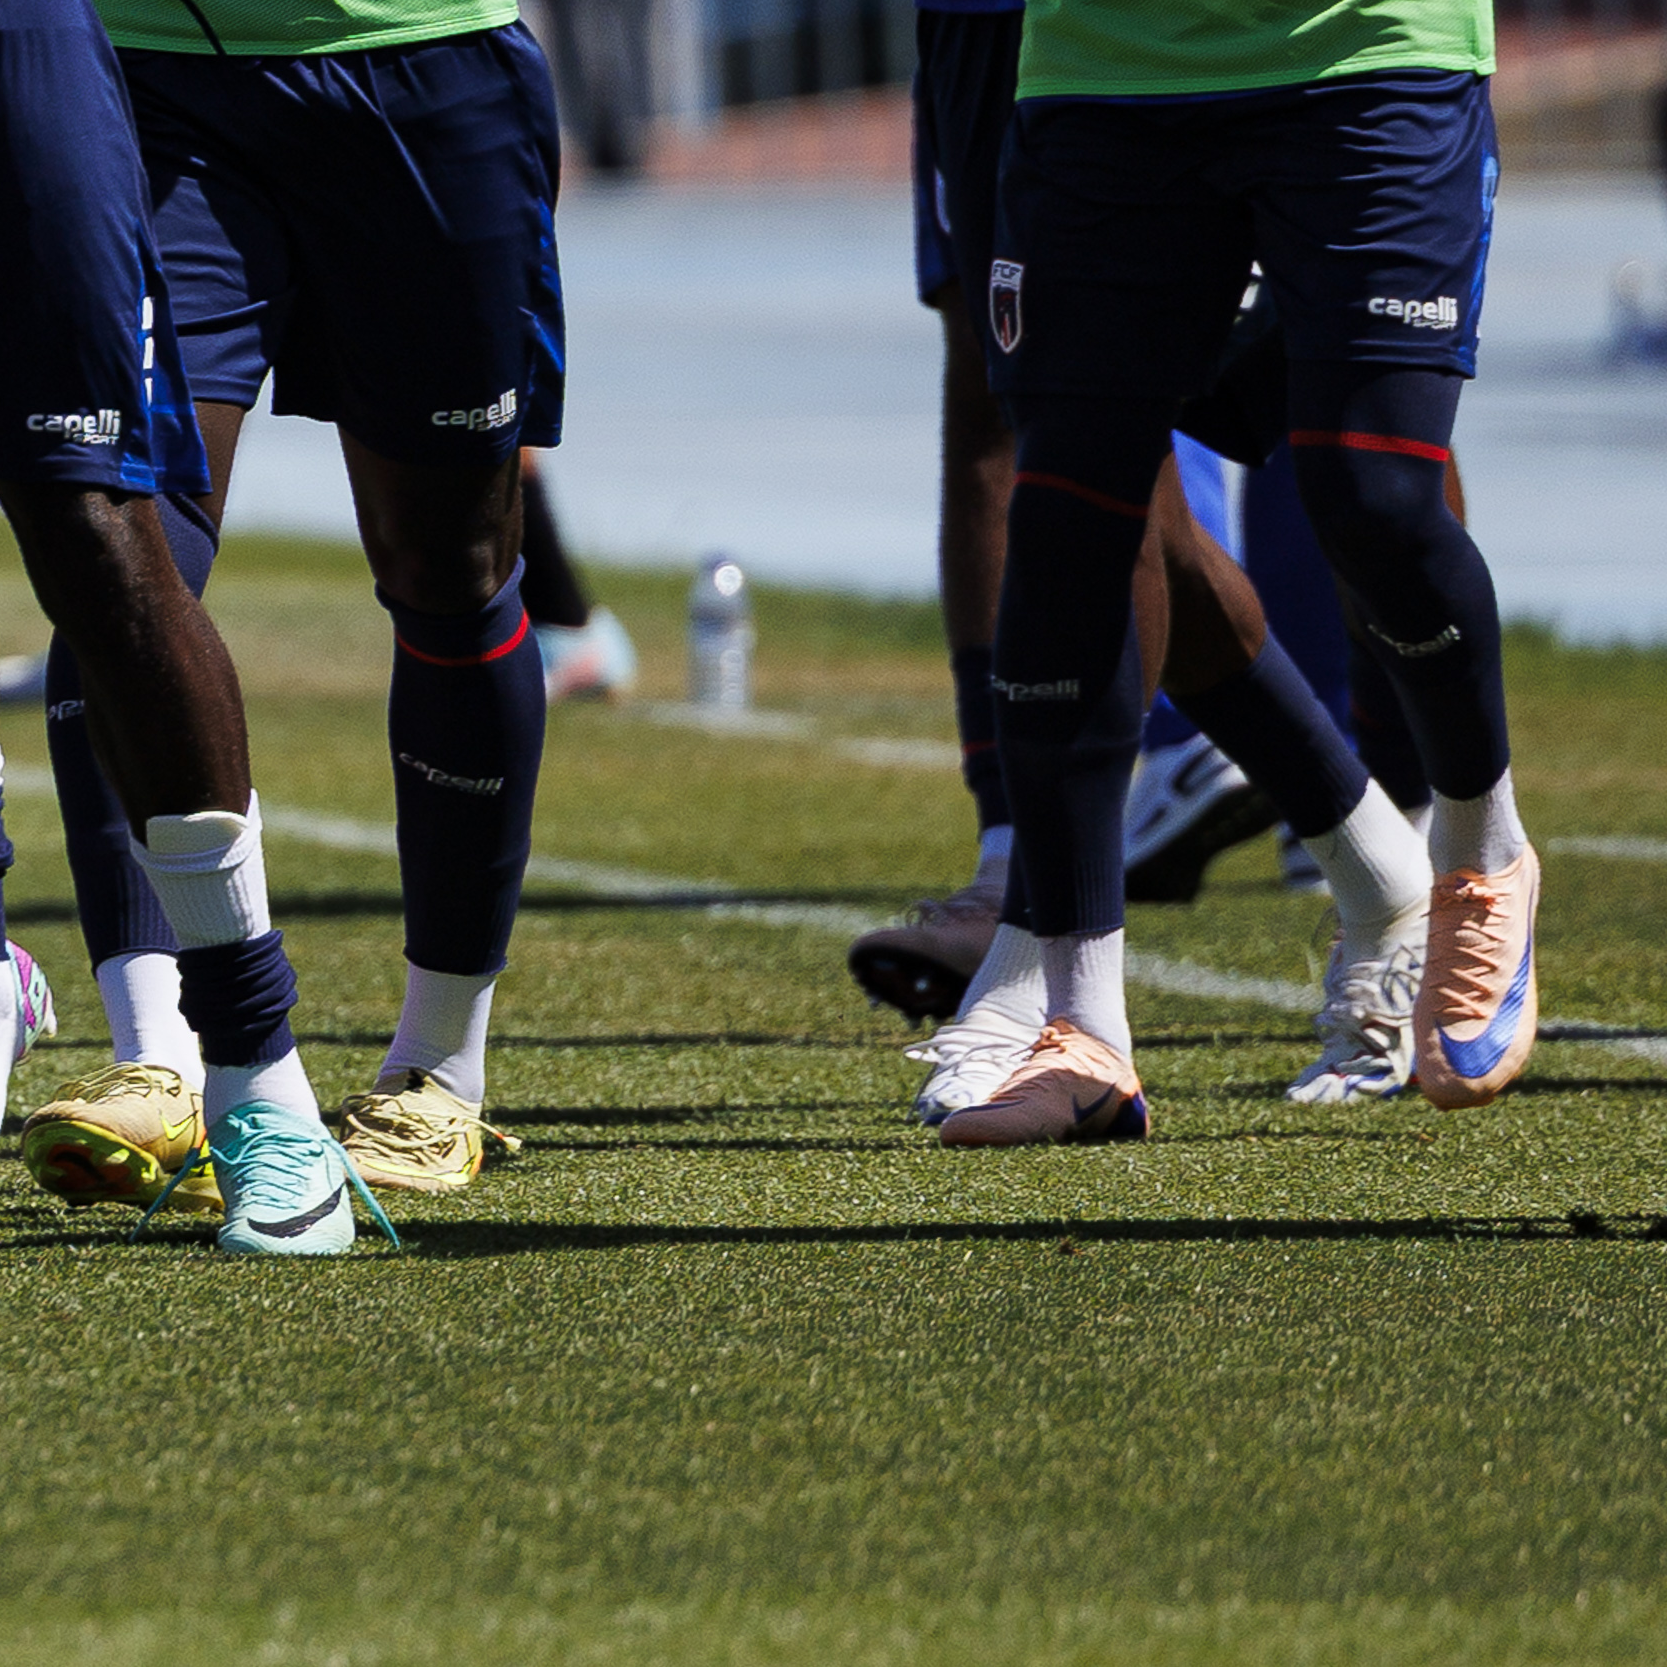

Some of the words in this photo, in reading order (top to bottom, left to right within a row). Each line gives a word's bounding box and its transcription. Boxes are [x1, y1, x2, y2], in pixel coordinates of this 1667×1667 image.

[1368, 296, 1458, 324] capelli
[431, 387, 516, 430] capelli
[27, 409, 121, 439] capelli
[73, 434, 119, 445] SPORT
